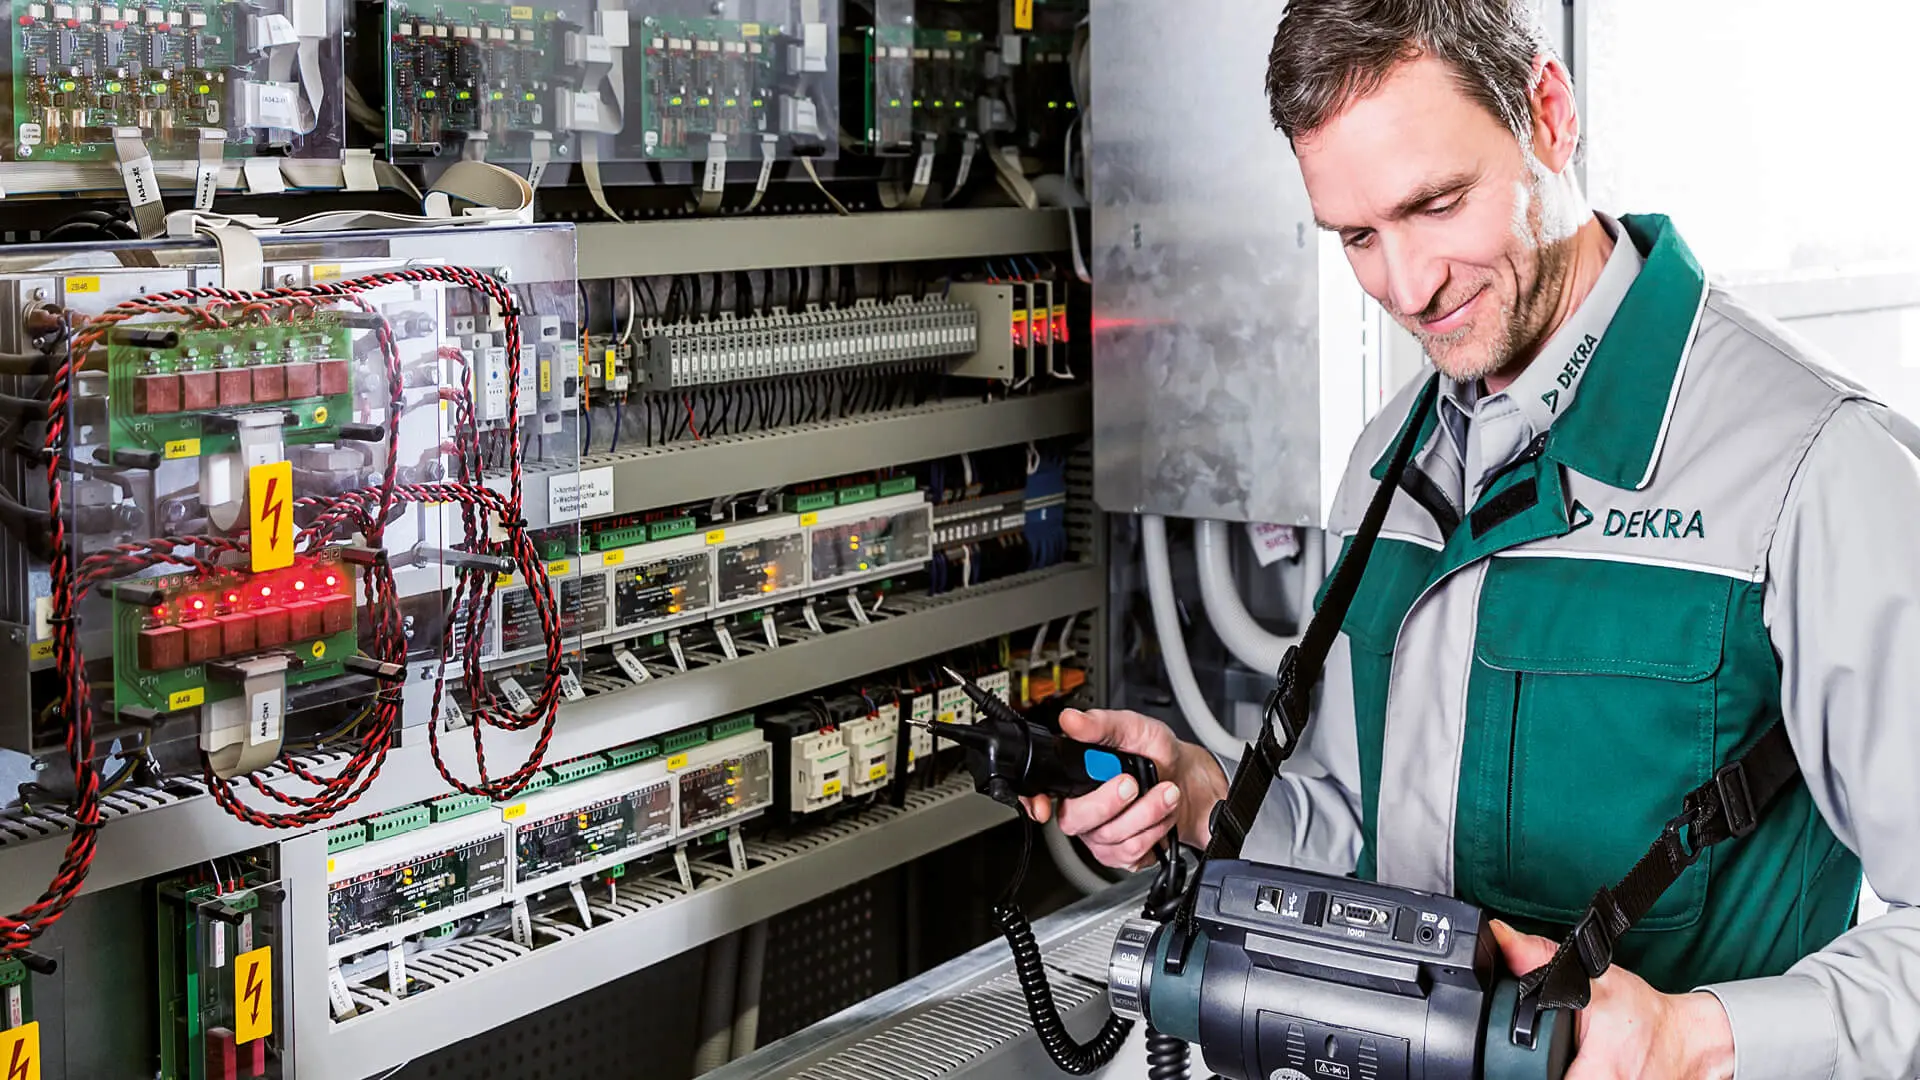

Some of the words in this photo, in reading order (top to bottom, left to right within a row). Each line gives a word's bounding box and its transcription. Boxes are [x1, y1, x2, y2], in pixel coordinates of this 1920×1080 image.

[1556, 333, 1598, 390] DEKRA
[1603, 508, 1705, 538] DEKRA
[1121, 952, 1139, 962] AUTO
